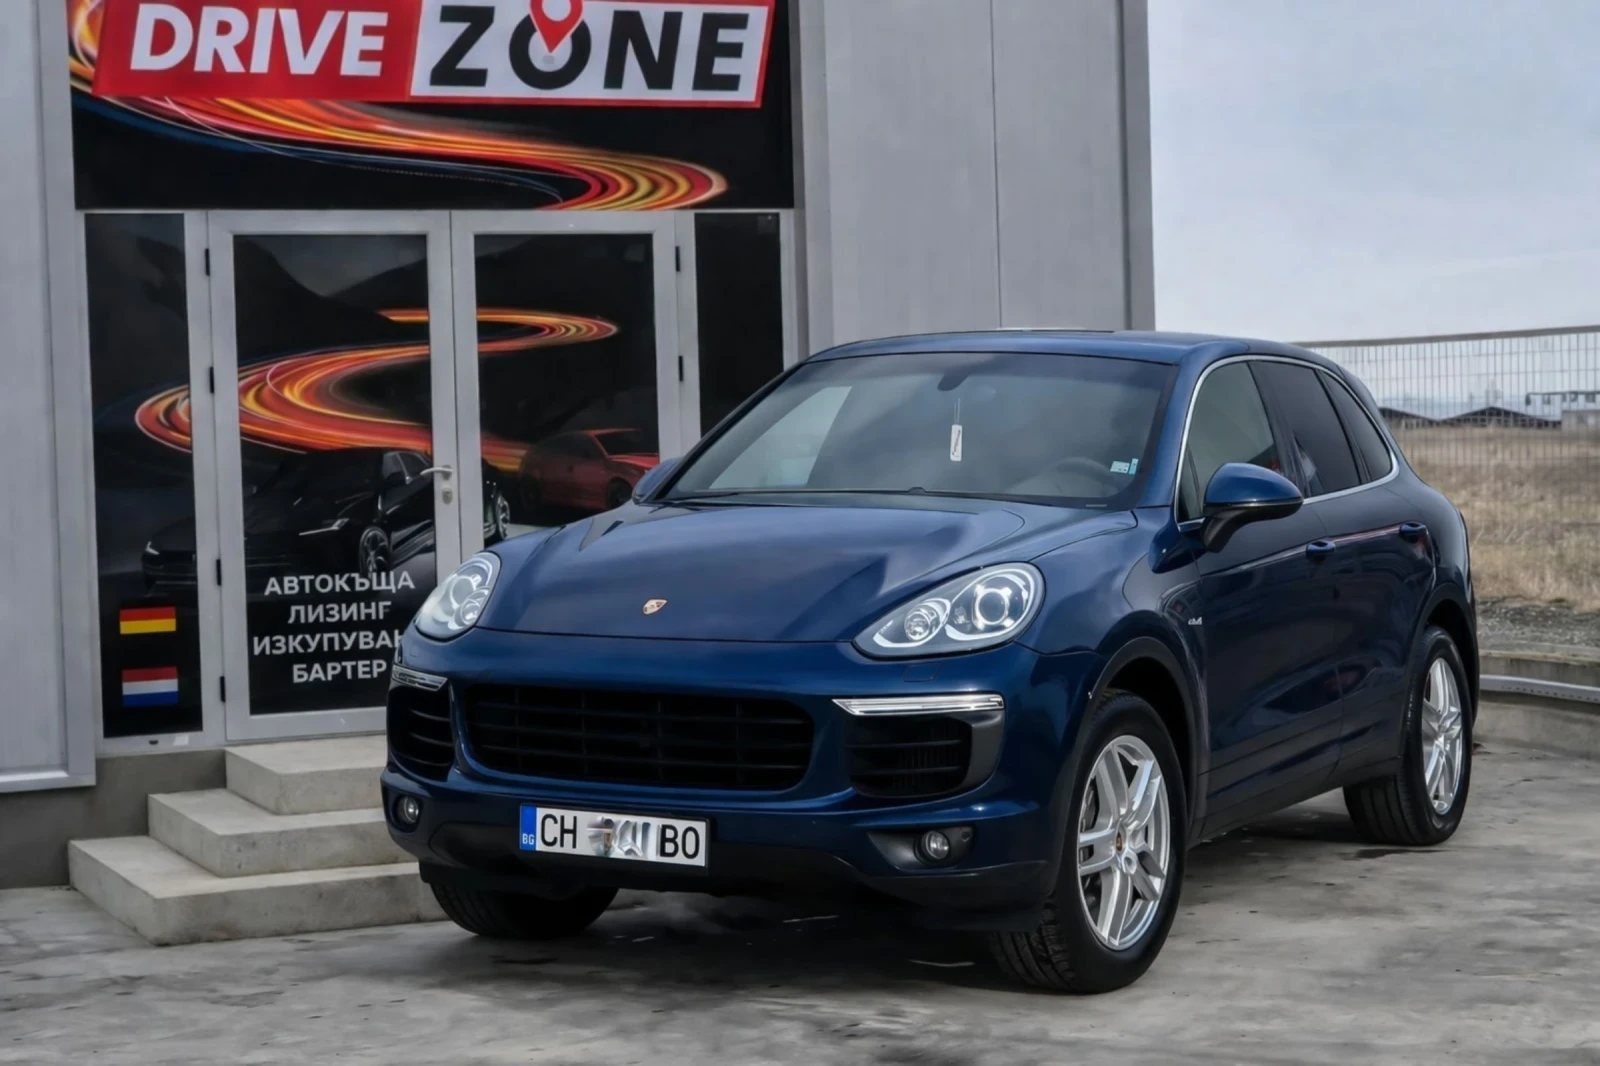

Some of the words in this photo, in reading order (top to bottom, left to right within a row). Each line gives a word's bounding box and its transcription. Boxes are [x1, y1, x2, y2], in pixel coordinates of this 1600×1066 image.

[129, 4, 389, 77] DRIVE
[429, 3, 749, 92] ZONE
[264, 570, 416, 596] АВТОКЪЩА
[288, 601, 392, 624] ЛИЗИНГ
[293, 659, 387, 683] БАРТЕР
[522, 833, 535, 845] BG
